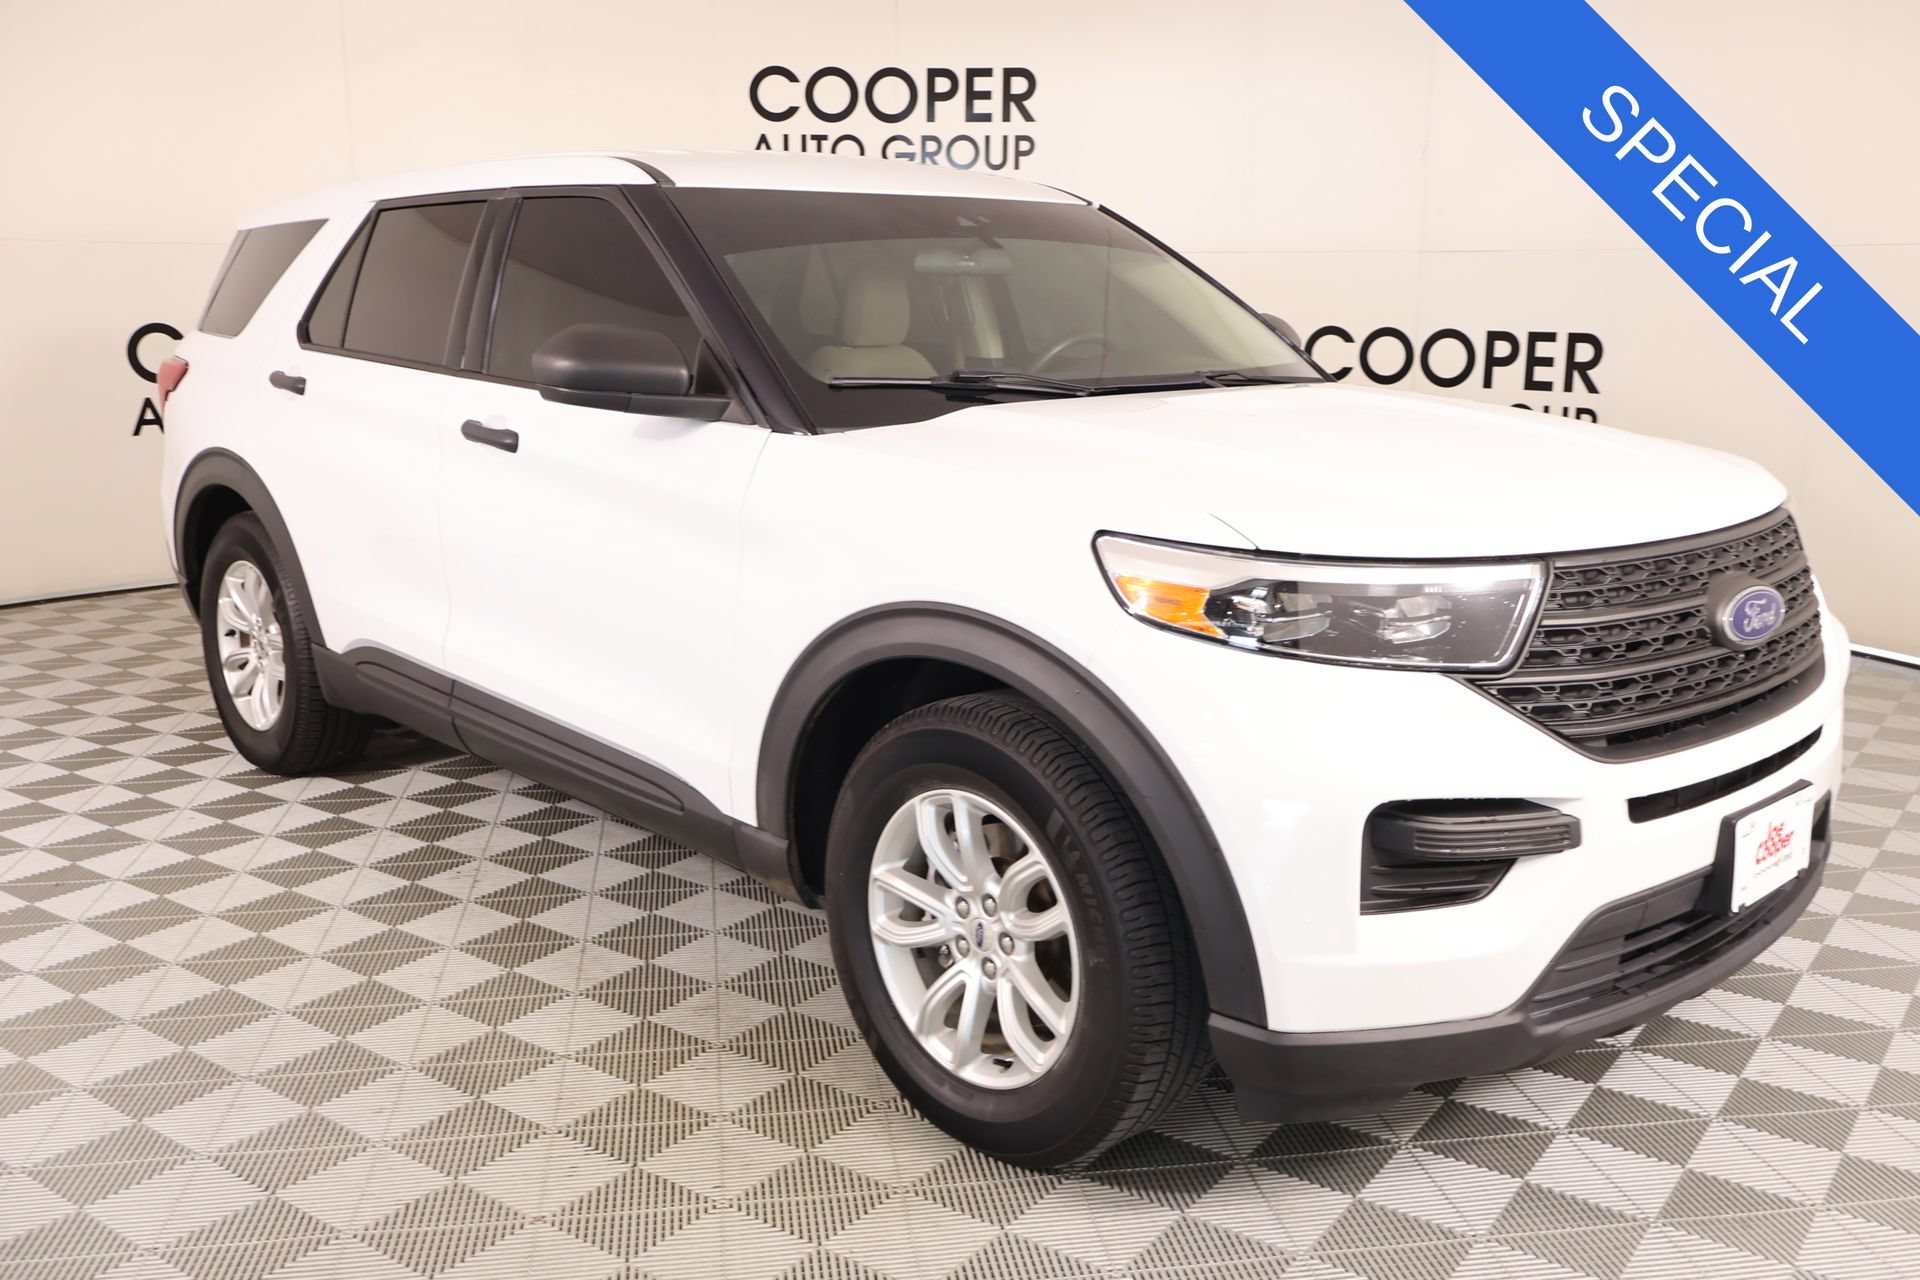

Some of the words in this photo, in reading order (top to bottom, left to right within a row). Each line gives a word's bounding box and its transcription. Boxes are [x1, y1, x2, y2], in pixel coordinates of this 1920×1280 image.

[749, 65, 1037, 124] COOPER
[881, 133, 1036, 171] GROUP
[1304, 325, 1604, 395] COOPER
[1743, 598, 1777, 633] Ford
